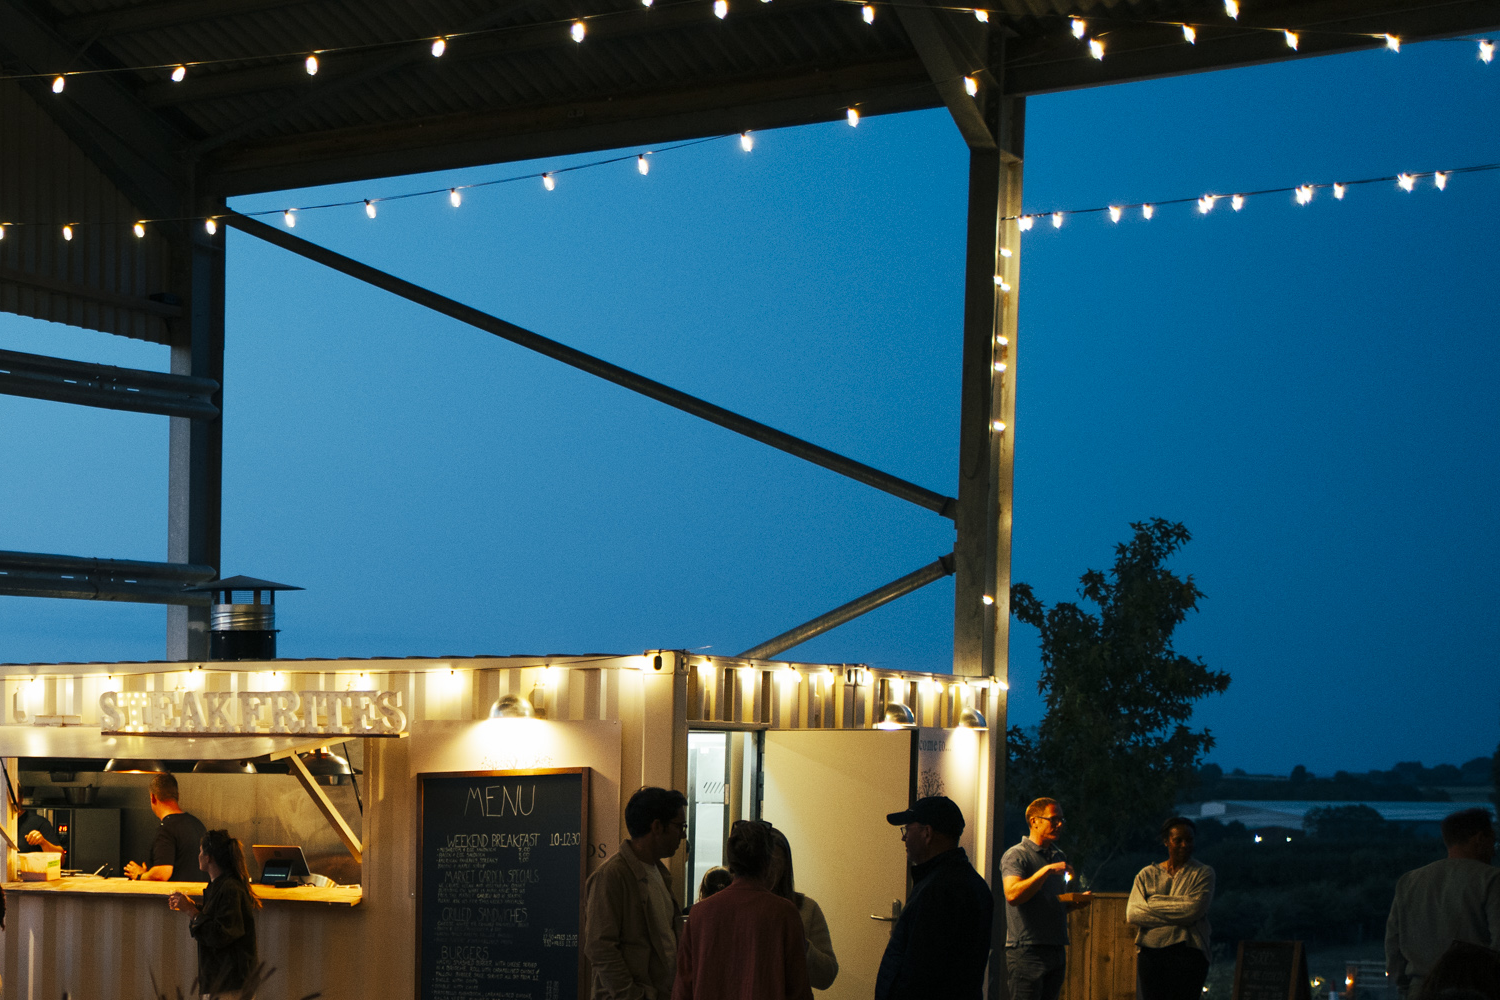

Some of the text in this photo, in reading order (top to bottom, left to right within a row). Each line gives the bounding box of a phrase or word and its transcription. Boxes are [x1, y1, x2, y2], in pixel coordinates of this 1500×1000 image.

[100, 690, 407, 734] STEAK FRITES
[919, 740, 938, 751] come
[464, 785, 536, 817] MENU
[446, 833, 489, 848] WEEKEND
[491, 833, 541, 848] BREAKFAST
[444, 869, 540, 883] MARKET GARDEN SPECIALS
[441, 907, 528, 923] GRILLED SANDWICHES
[441, 945, 490, 960] BURGERS
